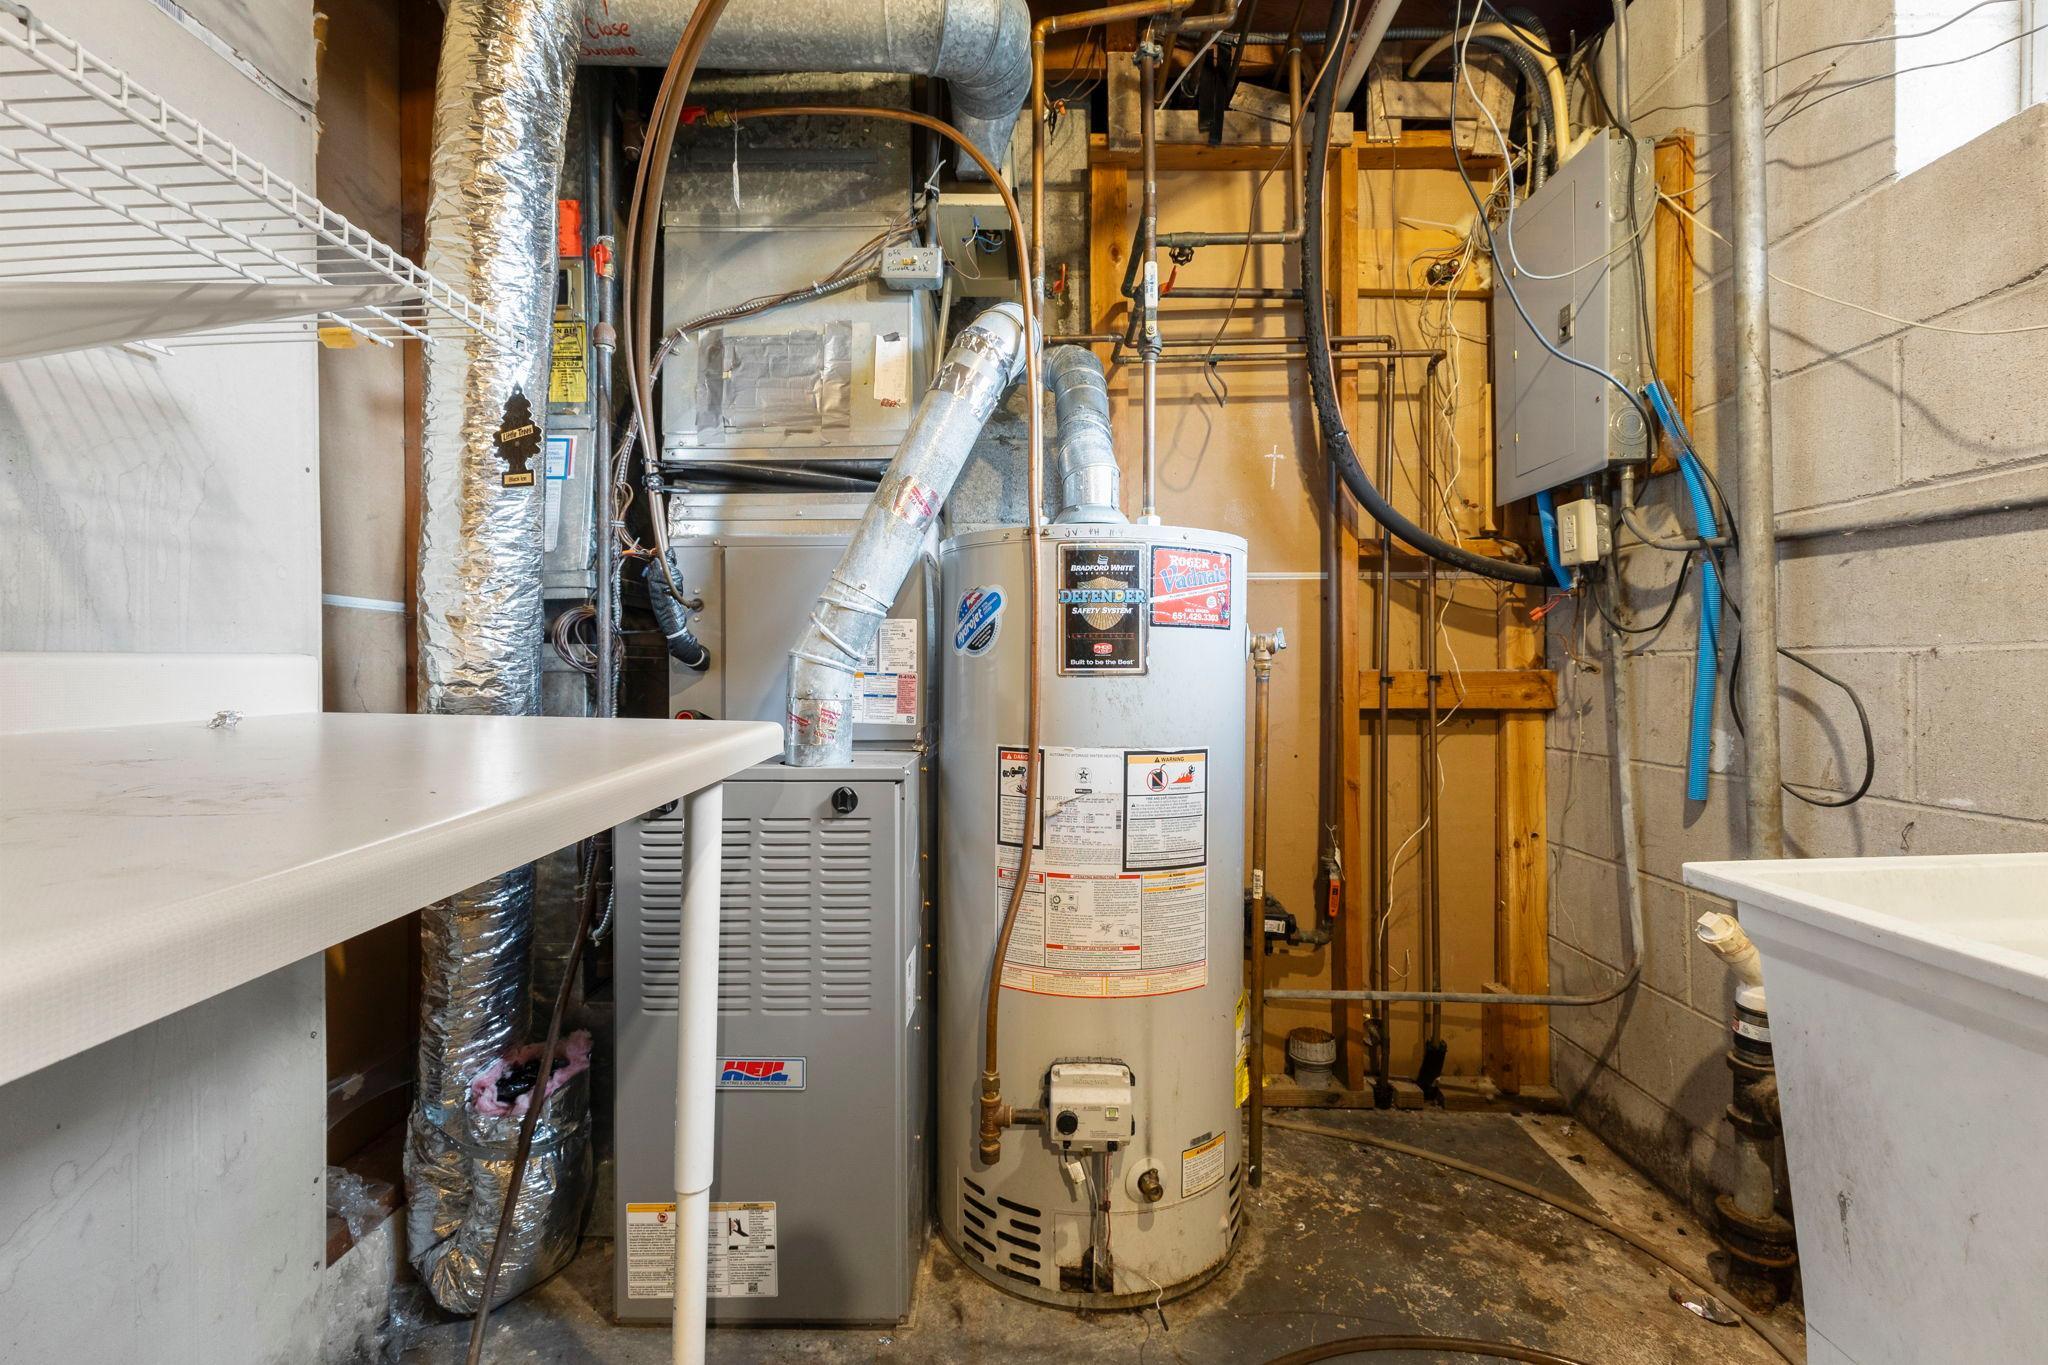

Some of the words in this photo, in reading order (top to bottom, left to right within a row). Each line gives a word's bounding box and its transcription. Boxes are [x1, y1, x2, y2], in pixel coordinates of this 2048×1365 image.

[584, 17, 631, 39] Close
[503, 432, 517, 440] Little
[519, 428, 532, 437] Trees
[1169, 555, 1210, 569] ROGER
[1160, 564, 1226, 592] Vadnais
[1059, 588, 1147, 603] DEFENDER
[721, 1061, 789, 1081] HEIL
